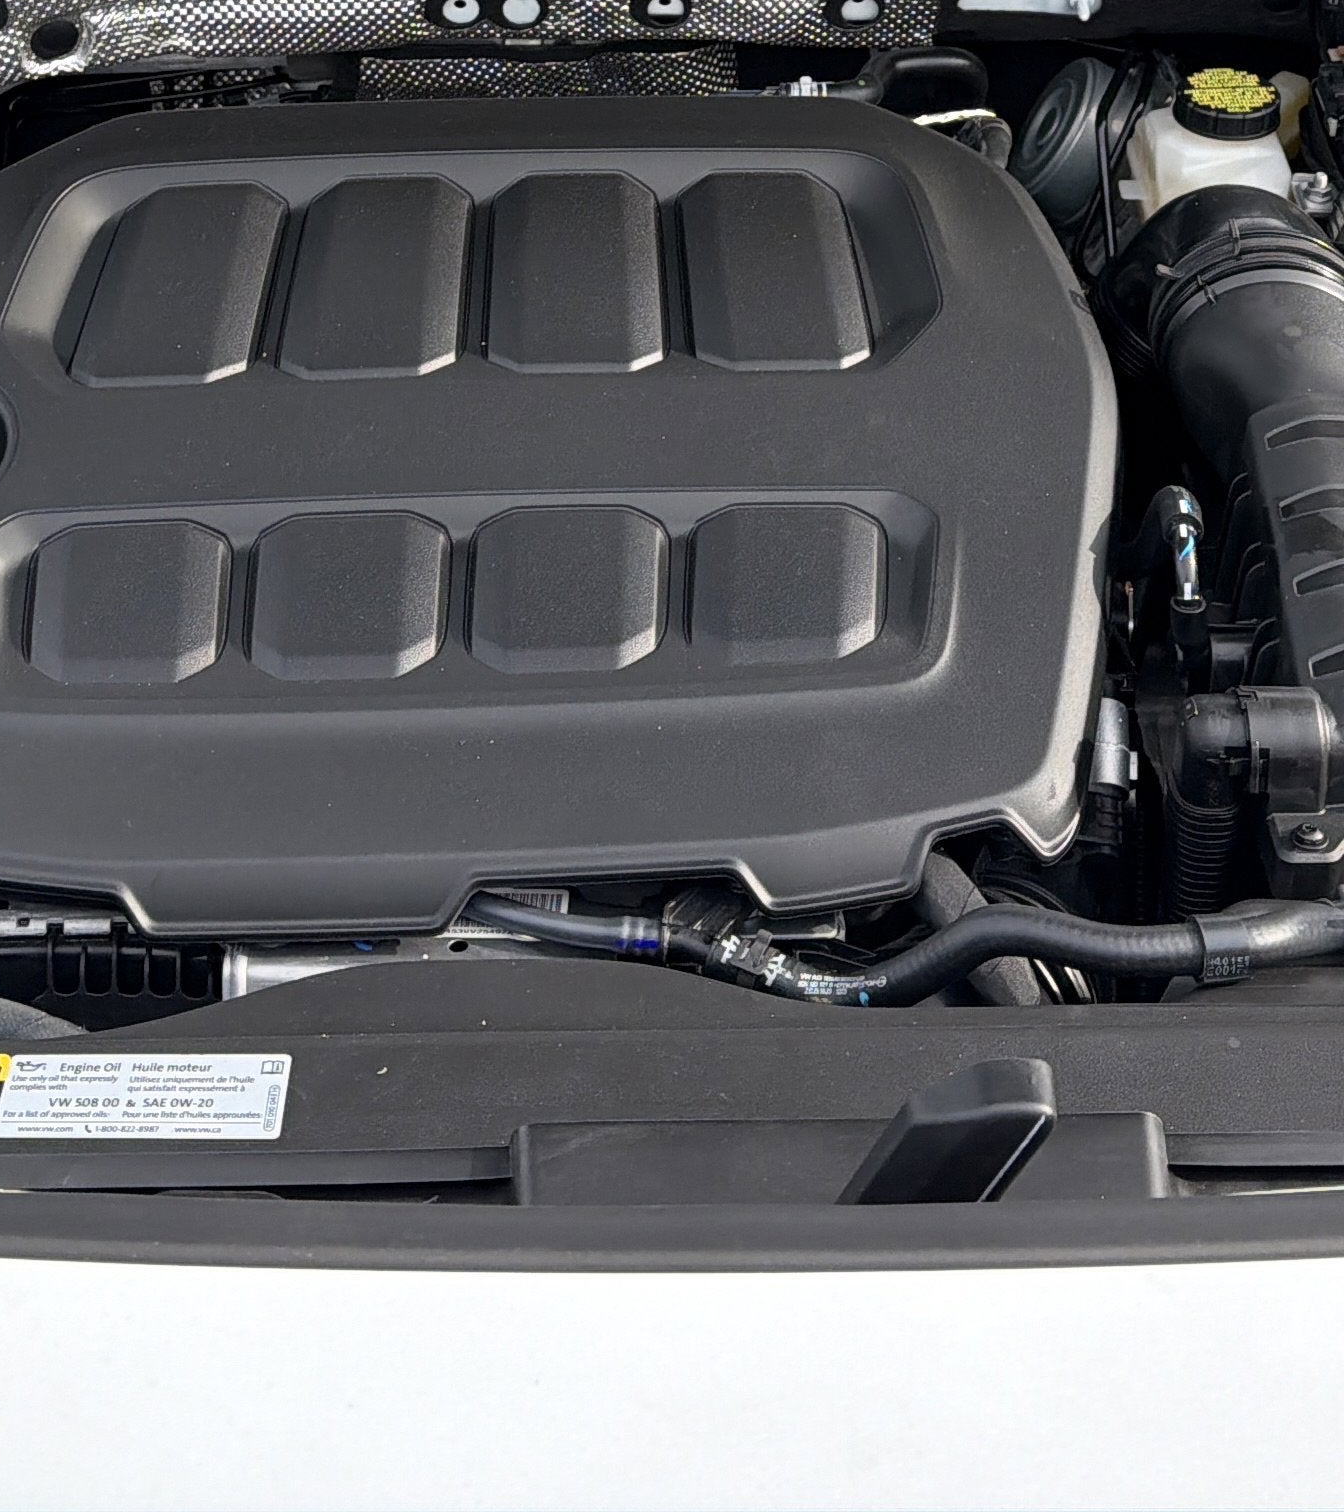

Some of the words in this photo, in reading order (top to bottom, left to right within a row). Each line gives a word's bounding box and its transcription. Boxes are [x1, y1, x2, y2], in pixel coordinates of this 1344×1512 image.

[60, 1063, 101, 1074] Engine
[104, 1063, 122, 1073] Oil
[131, 1062, 164, 1072] Huile
[167, 1063, 213, 1072] moteur
[29, 1075, 47, 1084] only
[79, 1076, 118, 1084] expressly
[162, 1076, 215, 1085] uniquement
[9, 1084, 47, 1092] complies
[127, 1085, 141, 1093] qui
[49, 1098, 72, 1107] VW
[75, 1098, 99, 1107] 508
[102, 1098, 120, 1107] 00
[126, 1100, 136, 1108] &
[142, 1098, 167, 1107] SAE
[170, 1098, 214, 1108] 0W-20
[3, 1110, 16, 1118] For
[25, 1110, 38, 1118] list
[40, 1110, 49, 1118] of
[50, 1110, 90, 1119] approved
[161, 1110, 178, 1118] liste
